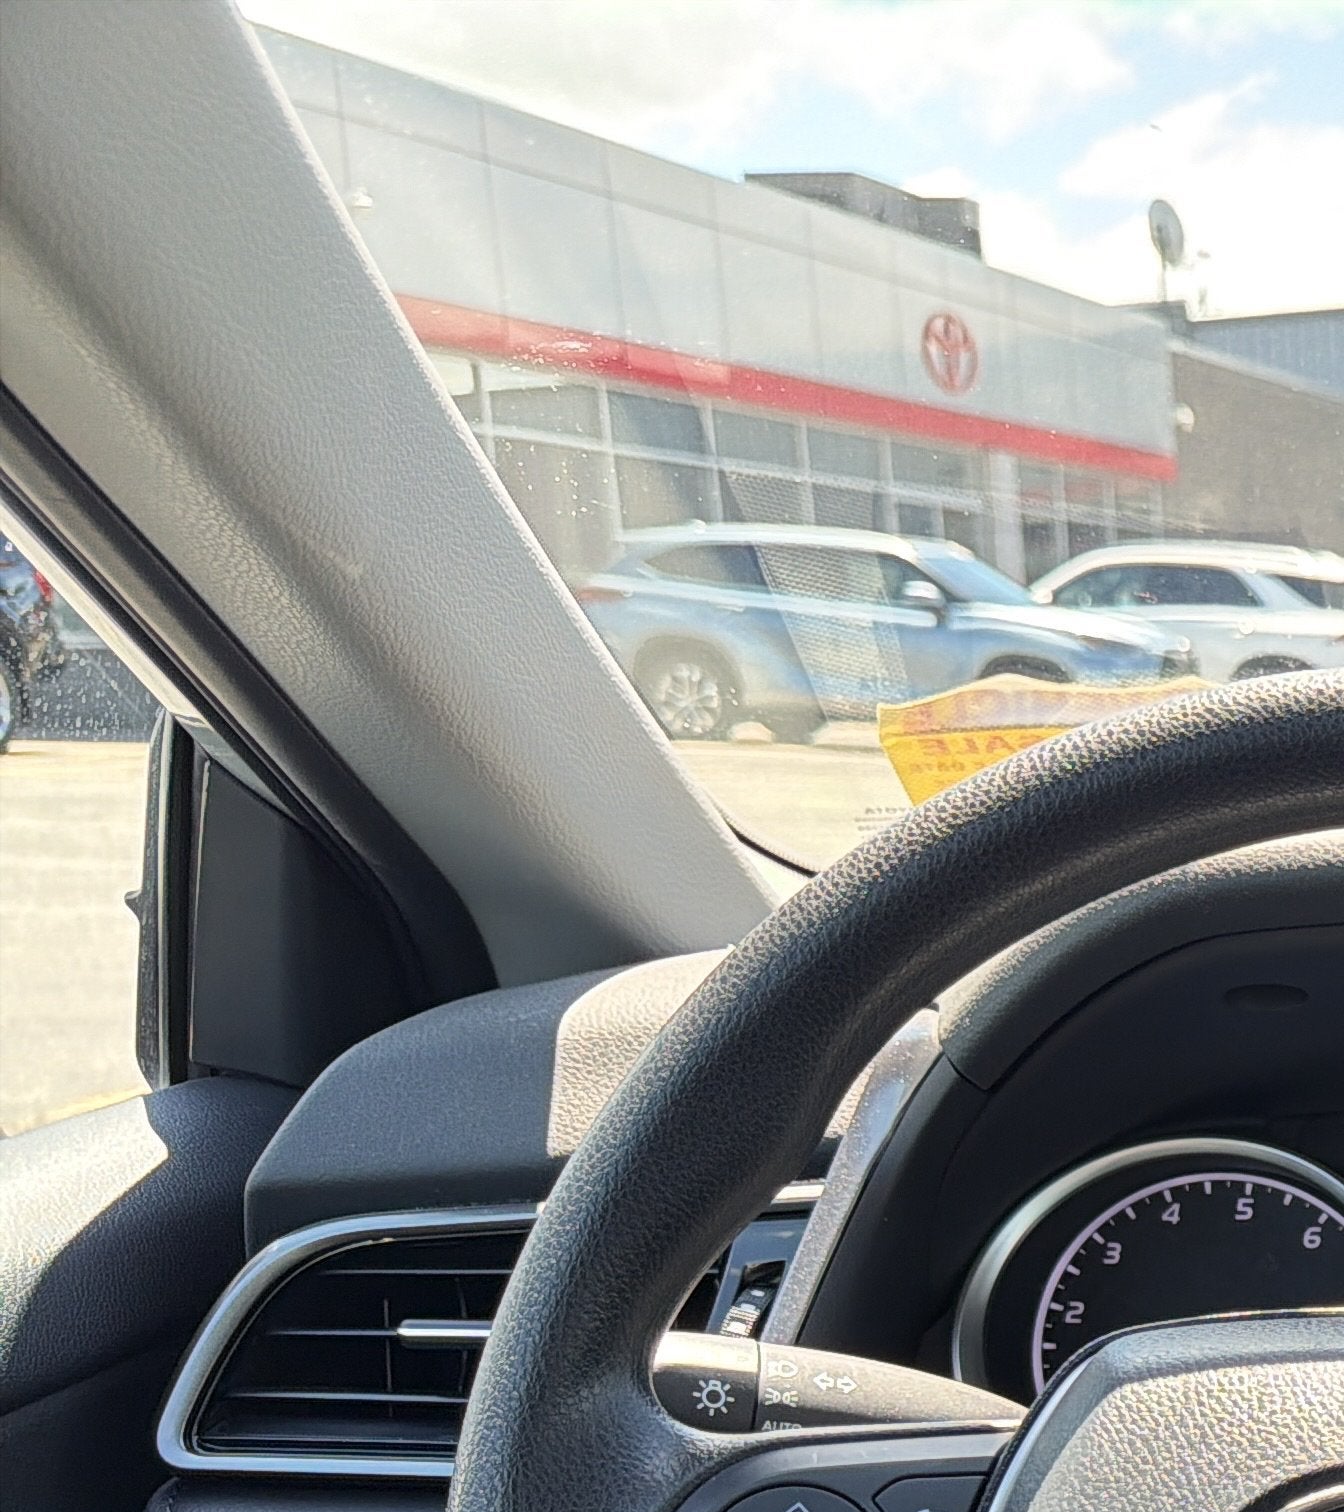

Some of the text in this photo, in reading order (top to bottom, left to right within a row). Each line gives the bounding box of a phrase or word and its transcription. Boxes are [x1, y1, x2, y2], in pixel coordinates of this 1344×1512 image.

[1161, 1203, 1181, 1225] 4
[1234, 1198, 1255, 1223] 5
[1302, 1226, 1323, 1250] 6
[1102, 1240, 1122, 1266] 3
[1064, 1301, 1085, 1325] 2
[762, 1420, 803, 1432] AUTO
